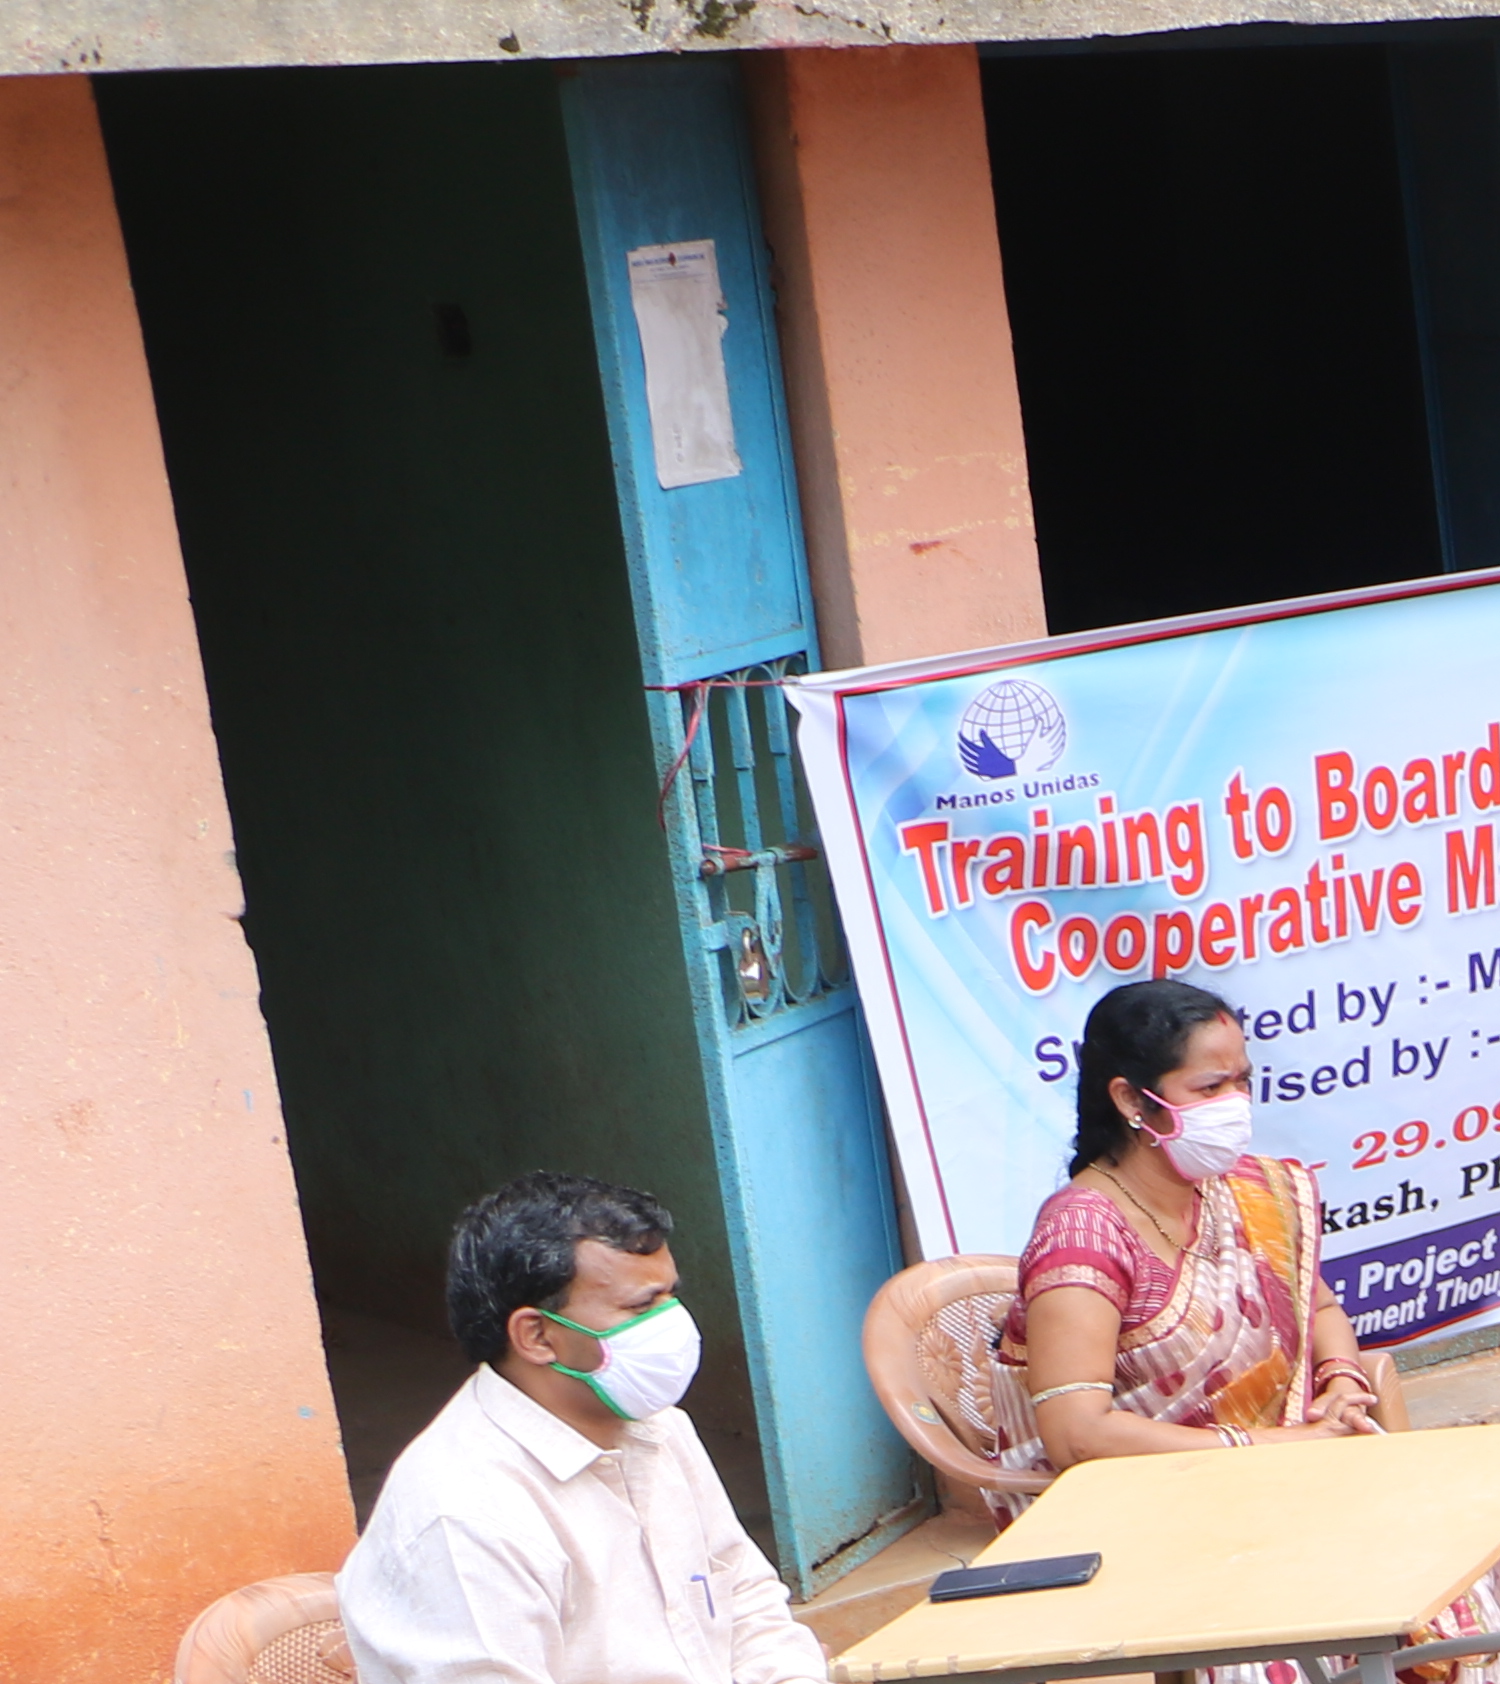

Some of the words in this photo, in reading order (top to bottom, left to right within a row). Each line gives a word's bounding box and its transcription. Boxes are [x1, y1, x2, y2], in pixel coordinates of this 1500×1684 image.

[936, 786, 1015, 811] Manos
[1023, 771, 1100, 800] Unidas
[903, 796, 1200, 914] Training
[1225, 770, 1292, 860] to
[1010, 854, 1421, 992] Cooperative
[1338, 981, 1398, 1028] by
[1391, 1035, 1450, 1080] by
[1358, 1228, 1498, 1300] Project
